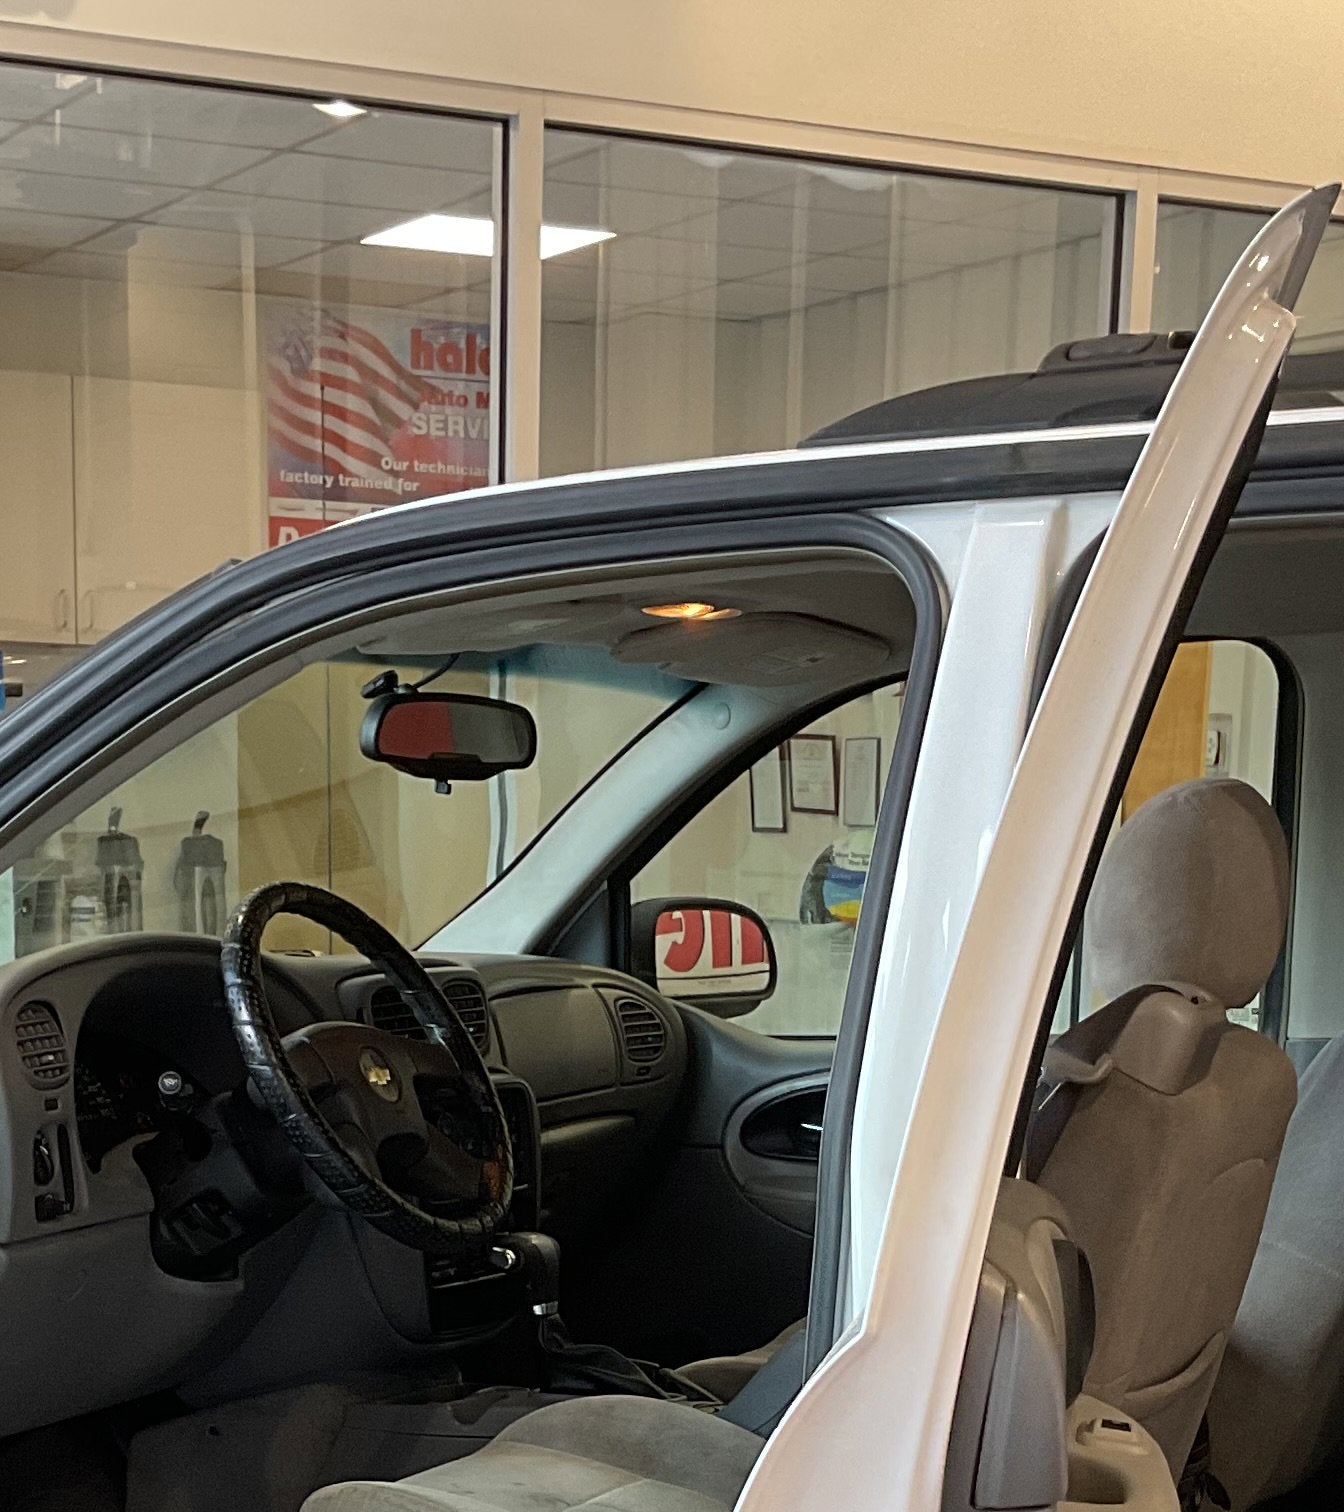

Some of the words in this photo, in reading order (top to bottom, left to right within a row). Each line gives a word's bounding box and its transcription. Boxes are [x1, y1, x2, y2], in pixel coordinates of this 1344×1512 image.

[381, 456, 409, 472] Our
[280, 470, 334, 488] factory
[338, 473, 393, 490] trained
[394, 477, 419, 495] for
